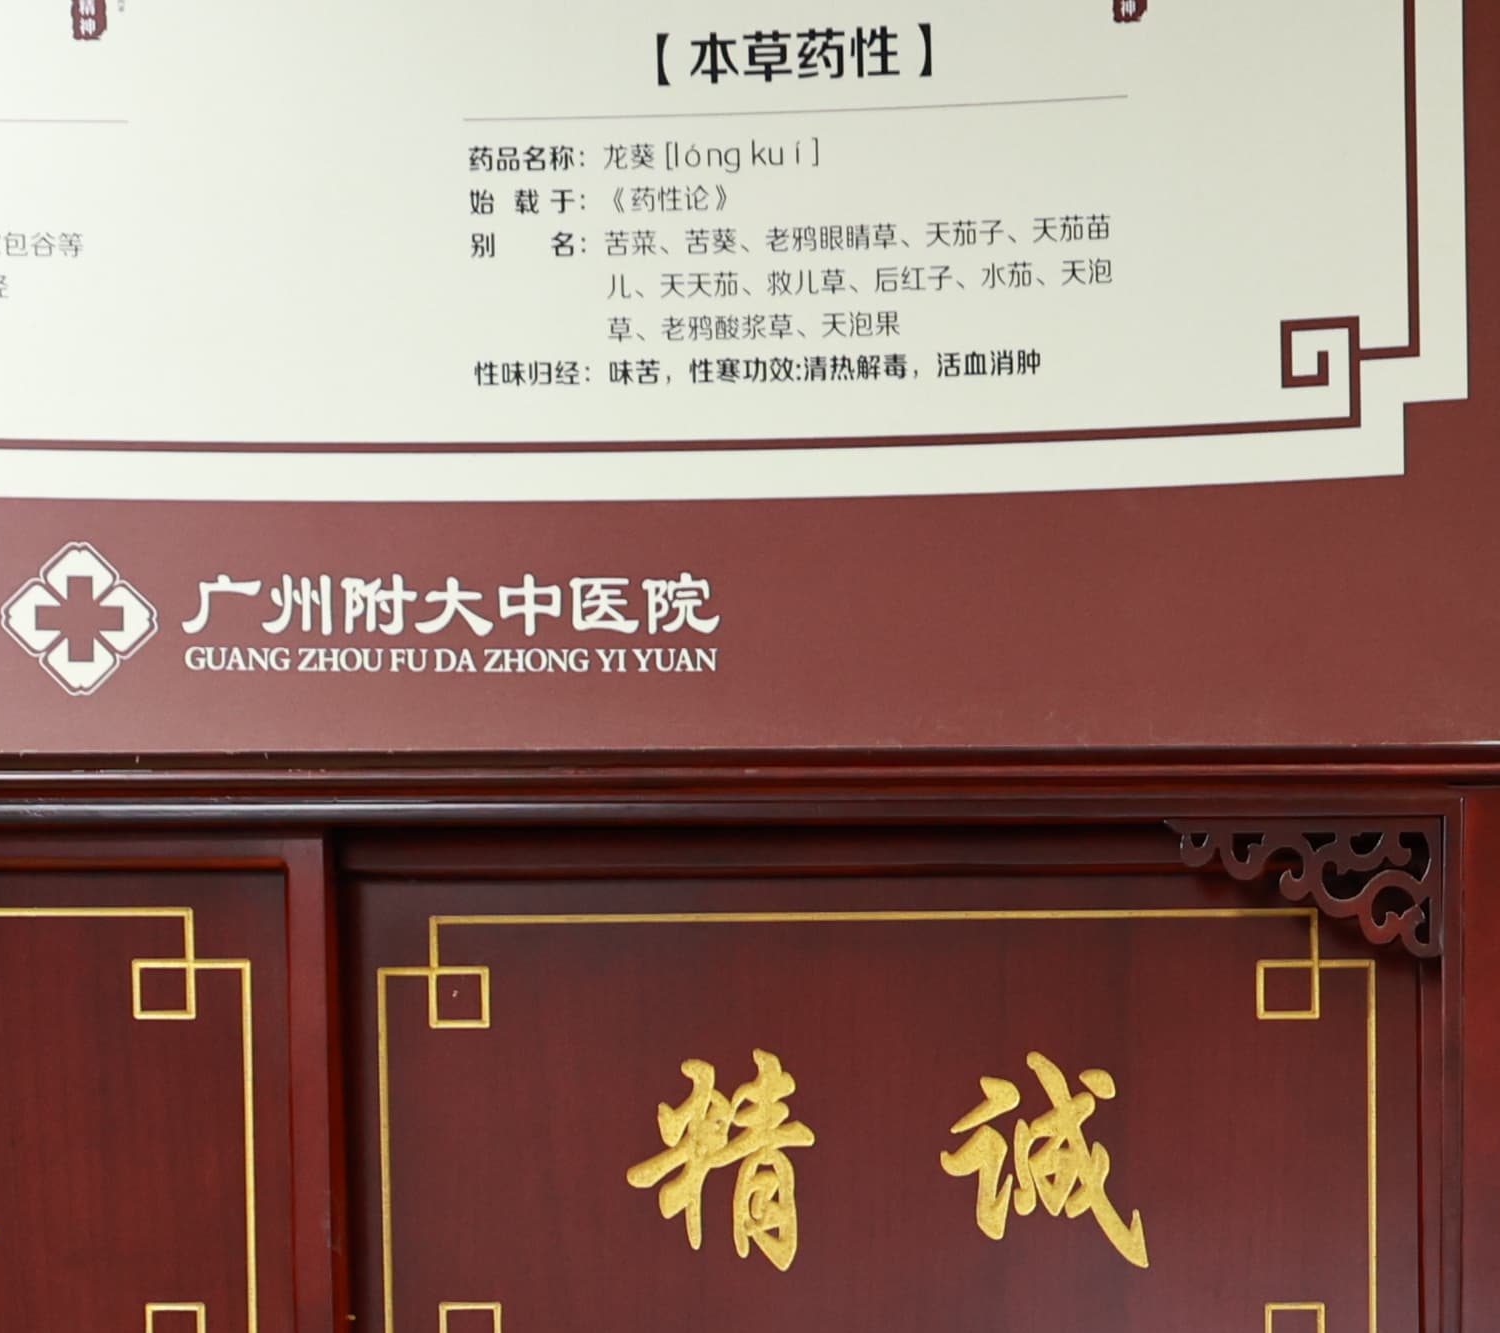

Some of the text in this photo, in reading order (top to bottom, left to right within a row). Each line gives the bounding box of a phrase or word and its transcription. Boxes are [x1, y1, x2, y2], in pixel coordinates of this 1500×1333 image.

[181, 572, 720, 637] 广州附大中医院
[184, 646, 717, 673] GUANG ZHOU FU DA ZHONG YI YUAN
